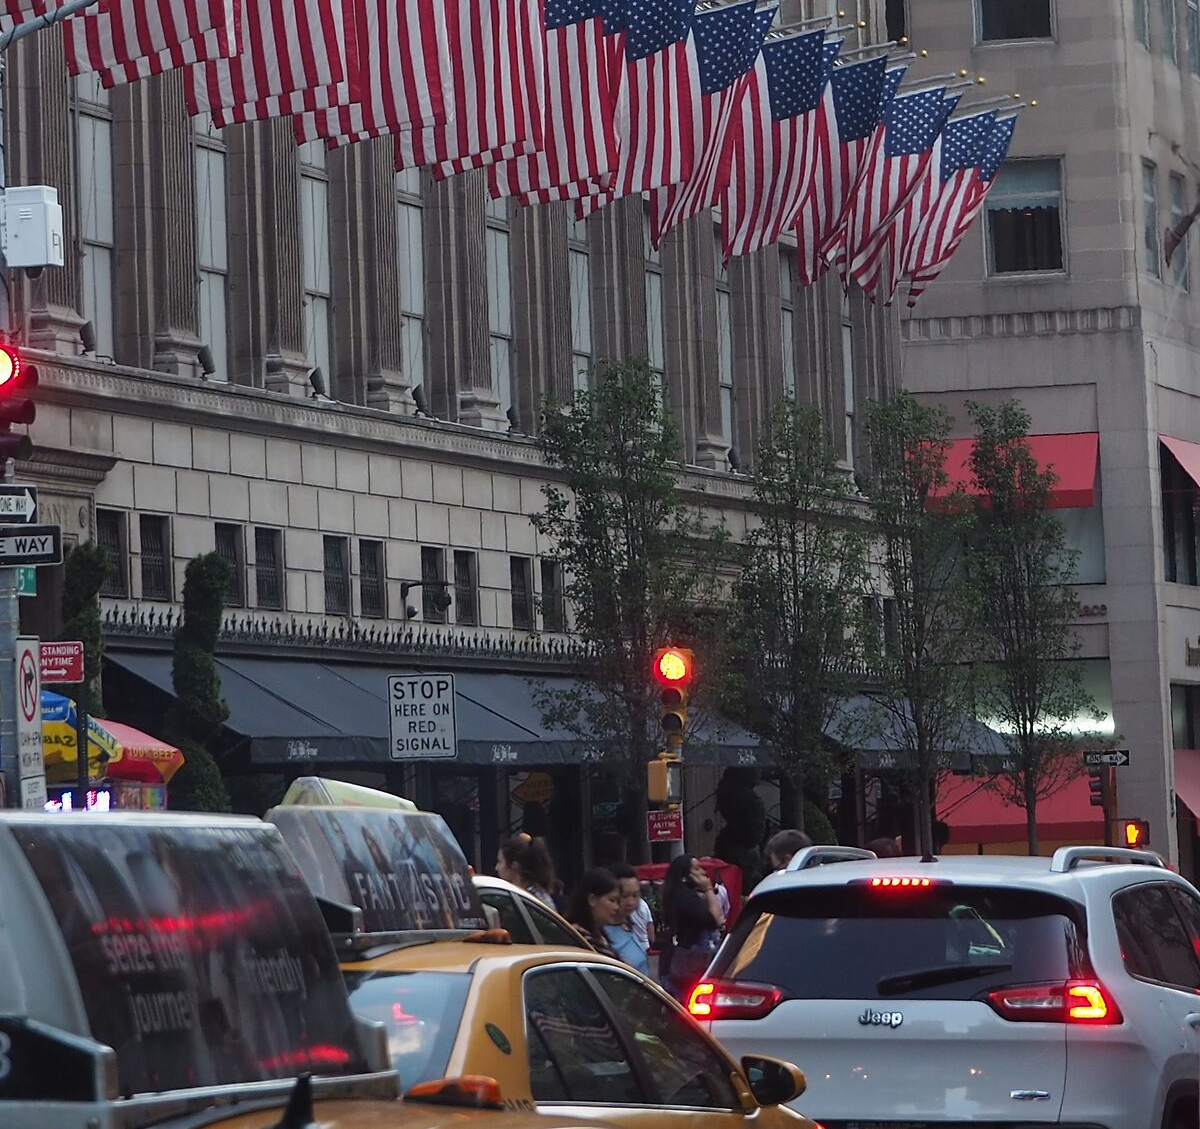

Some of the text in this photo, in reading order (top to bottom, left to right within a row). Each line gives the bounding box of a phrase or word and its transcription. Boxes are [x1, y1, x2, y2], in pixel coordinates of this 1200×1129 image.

[0, 497, 27, 512] ONE WAY
[14, 537, 48, 553] WAY
[41, 646, 80, 656] STANDING
[393, 681, 449, 699] STOP
[394, 703, 450, 717] HERE ON
[408, 721, 436, 733] RED
[396, 737, 450, 751] SIGNAL
[101, 932, 155, 973] seize
[241, 947, 308, 999] friendly
[858, 1008, 903, 1028] Jeep
